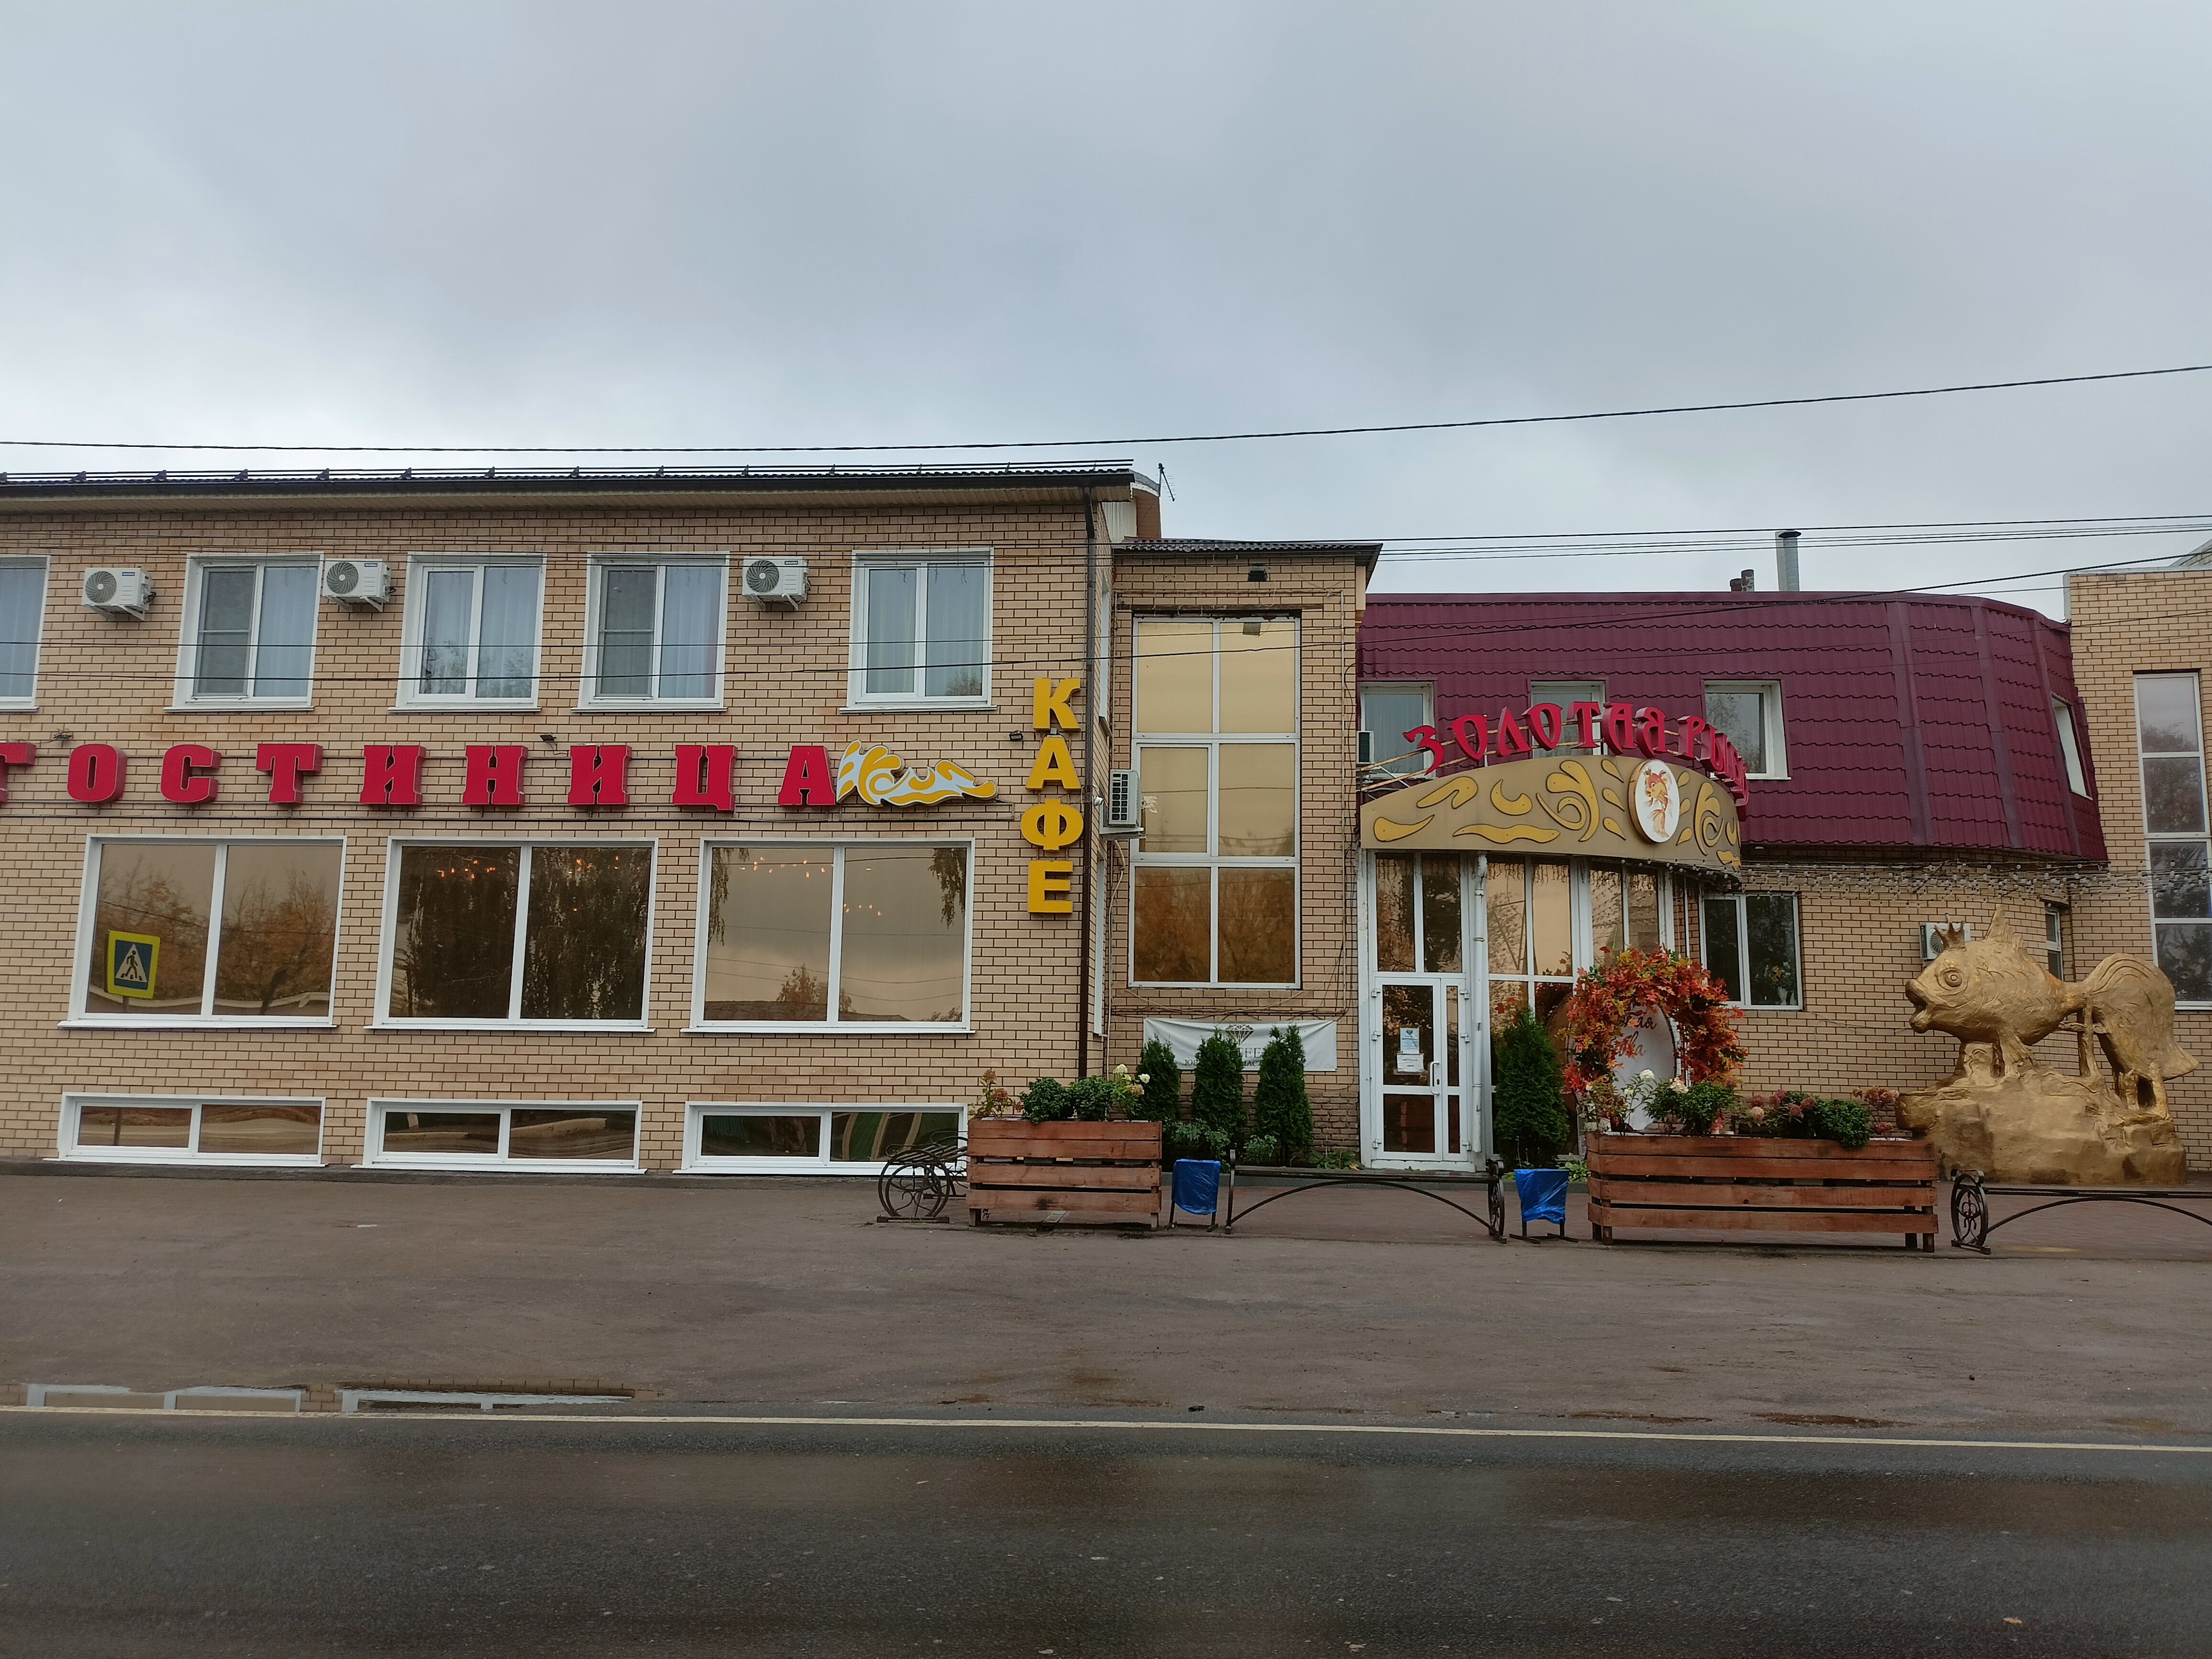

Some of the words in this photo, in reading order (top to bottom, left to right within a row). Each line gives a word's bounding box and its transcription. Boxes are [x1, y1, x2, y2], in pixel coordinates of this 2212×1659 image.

[1402, 702, 1668, 776] ЗОЛОТАЯ
[1674, 715, 1749, 821] РЫБ
[1020, 677, 1084, 914] КАФЕ
